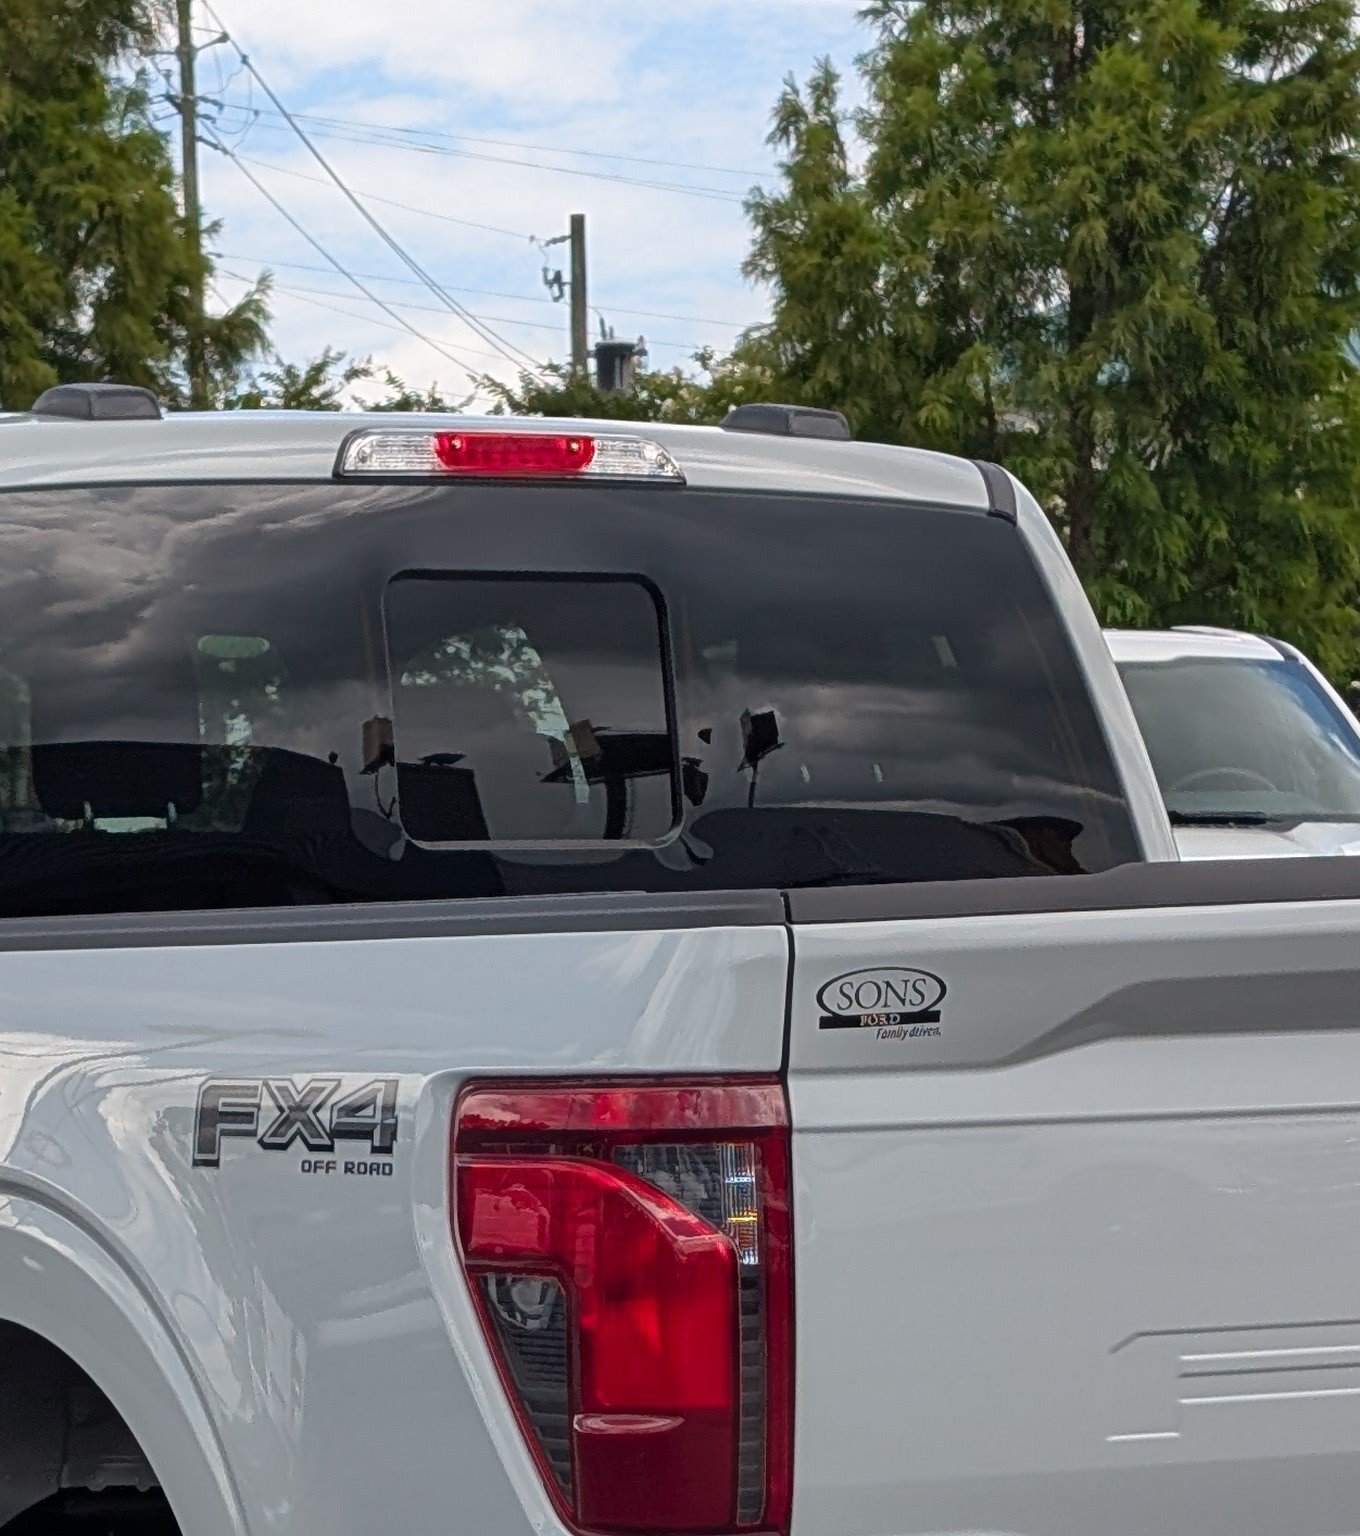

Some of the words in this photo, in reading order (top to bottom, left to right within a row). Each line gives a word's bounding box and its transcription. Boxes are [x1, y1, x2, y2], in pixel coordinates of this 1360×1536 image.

[836, 978, 927, 1010] SONS
[192, 1078, 399, 1168] FX4
[301, 1159, 337, 1174] OFF
[344, 1160, 393, 1176] ROAD
